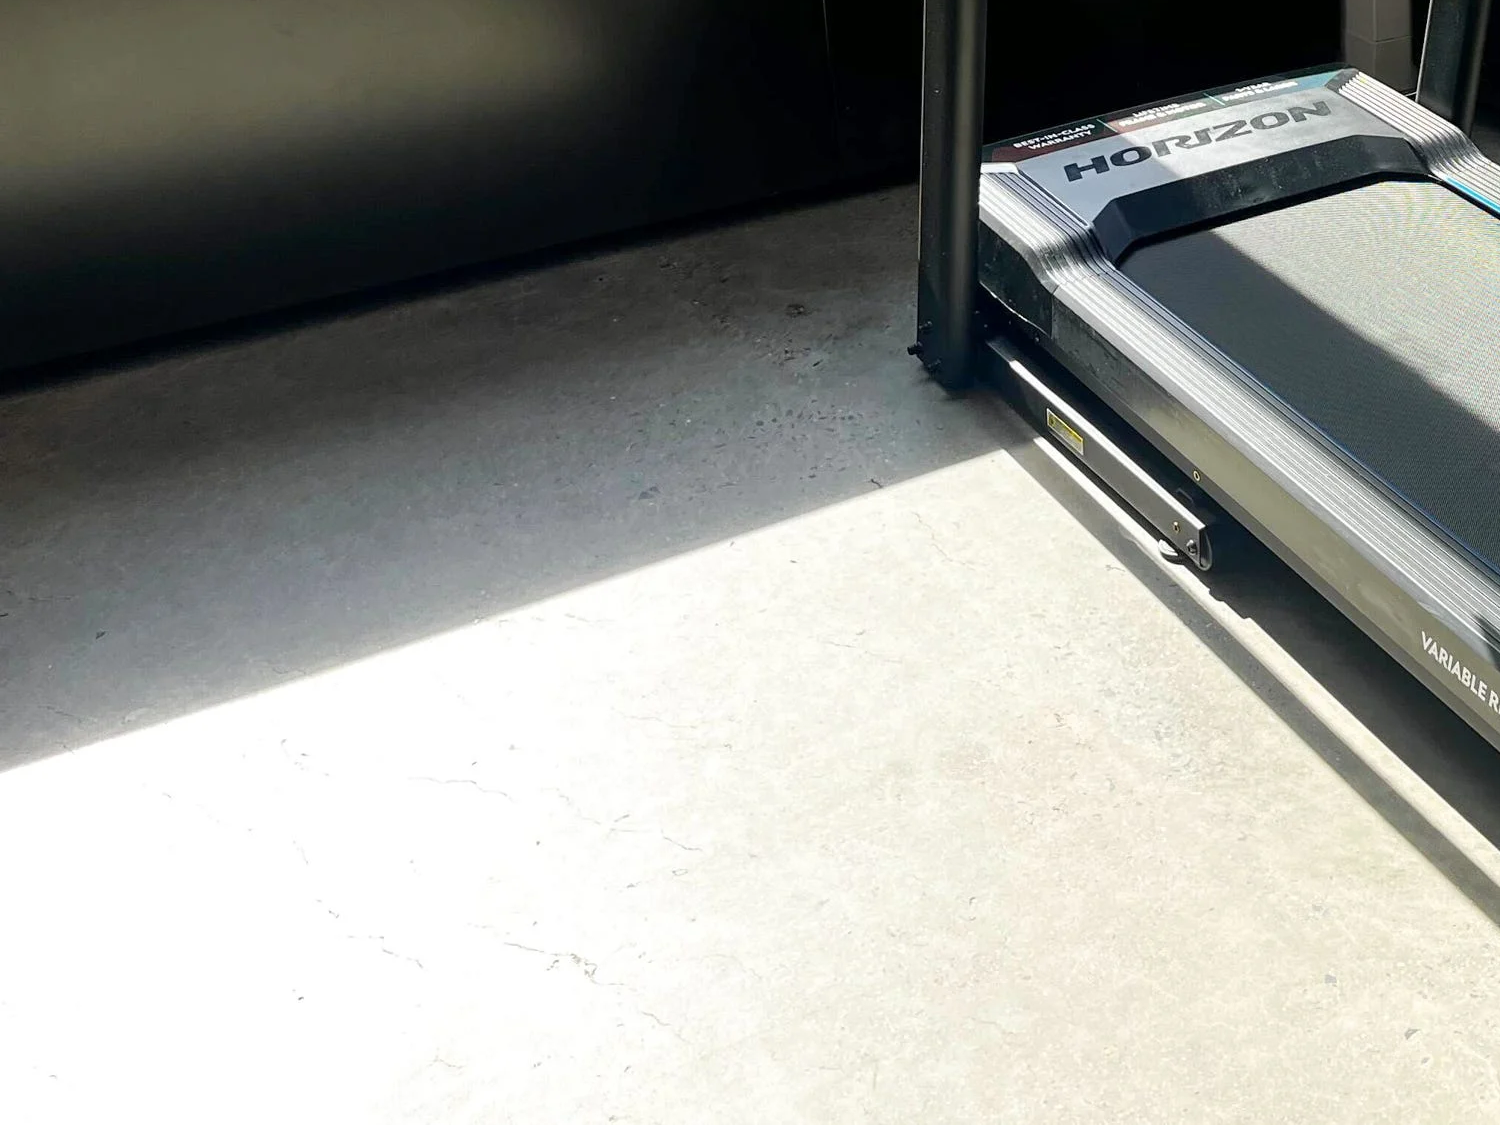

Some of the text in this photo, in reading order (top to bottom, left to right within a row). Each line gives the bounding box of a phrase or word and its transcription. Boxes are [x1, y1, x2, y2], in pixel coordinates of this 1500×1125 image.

[1013, 123, 1096, 149] BEST-IN-CLASS
[1028, 130, 1092, 150] WARRANTY
[1064, 101, 1332, 183] HORIZON
[1421, 631, 1488, 702] VARIABLE
